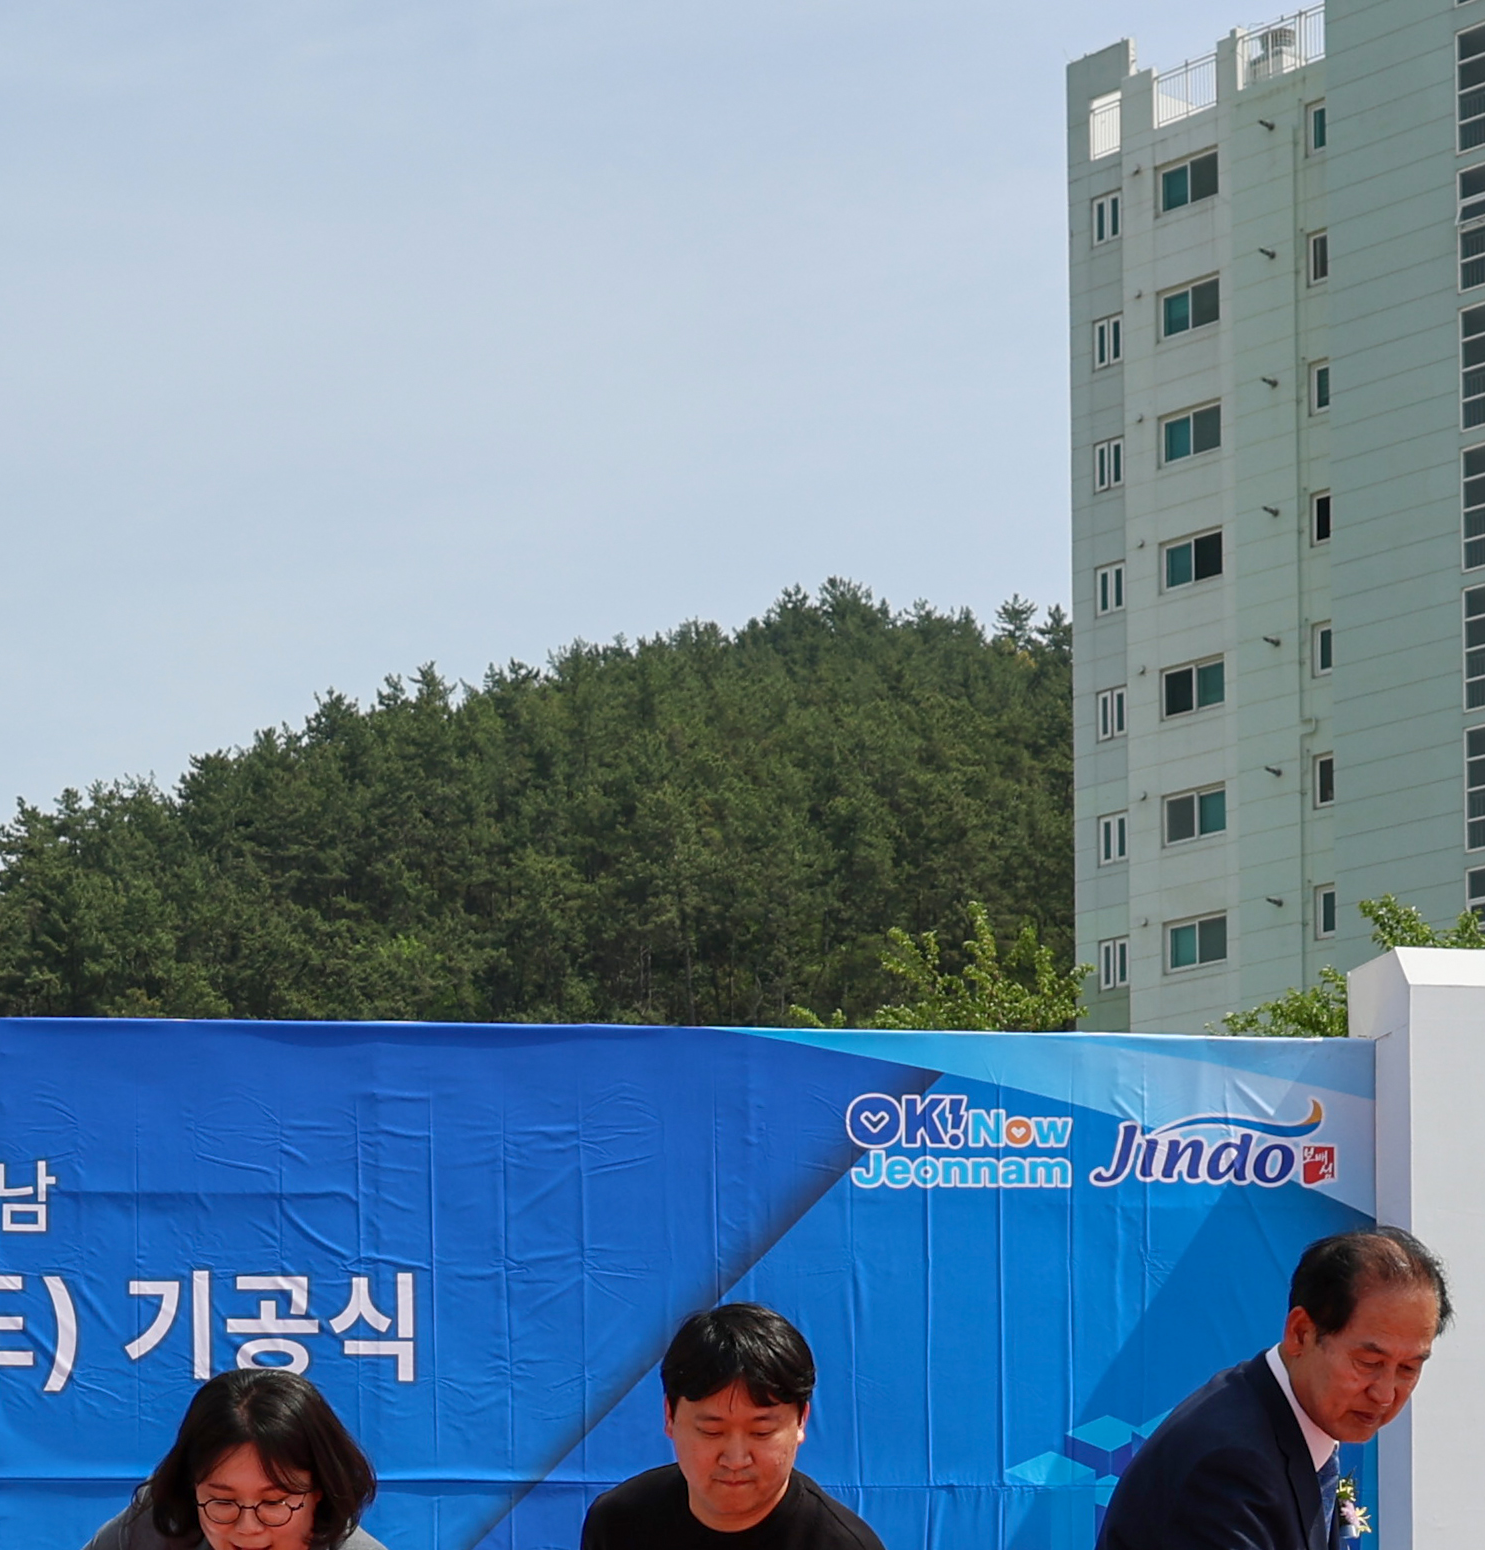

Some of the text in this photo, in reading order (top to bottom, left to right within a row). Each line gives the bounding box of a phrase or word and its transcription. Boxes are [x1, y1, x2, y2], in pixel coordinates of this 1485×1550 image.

[846, 1093, 1073, 1149] OK! Now
[851, 1150, 1072, 1189] Jeonnam
[1091, 1122, 1297, 1186] Jindo
[127, 1270, 417, 1384] 기공식
